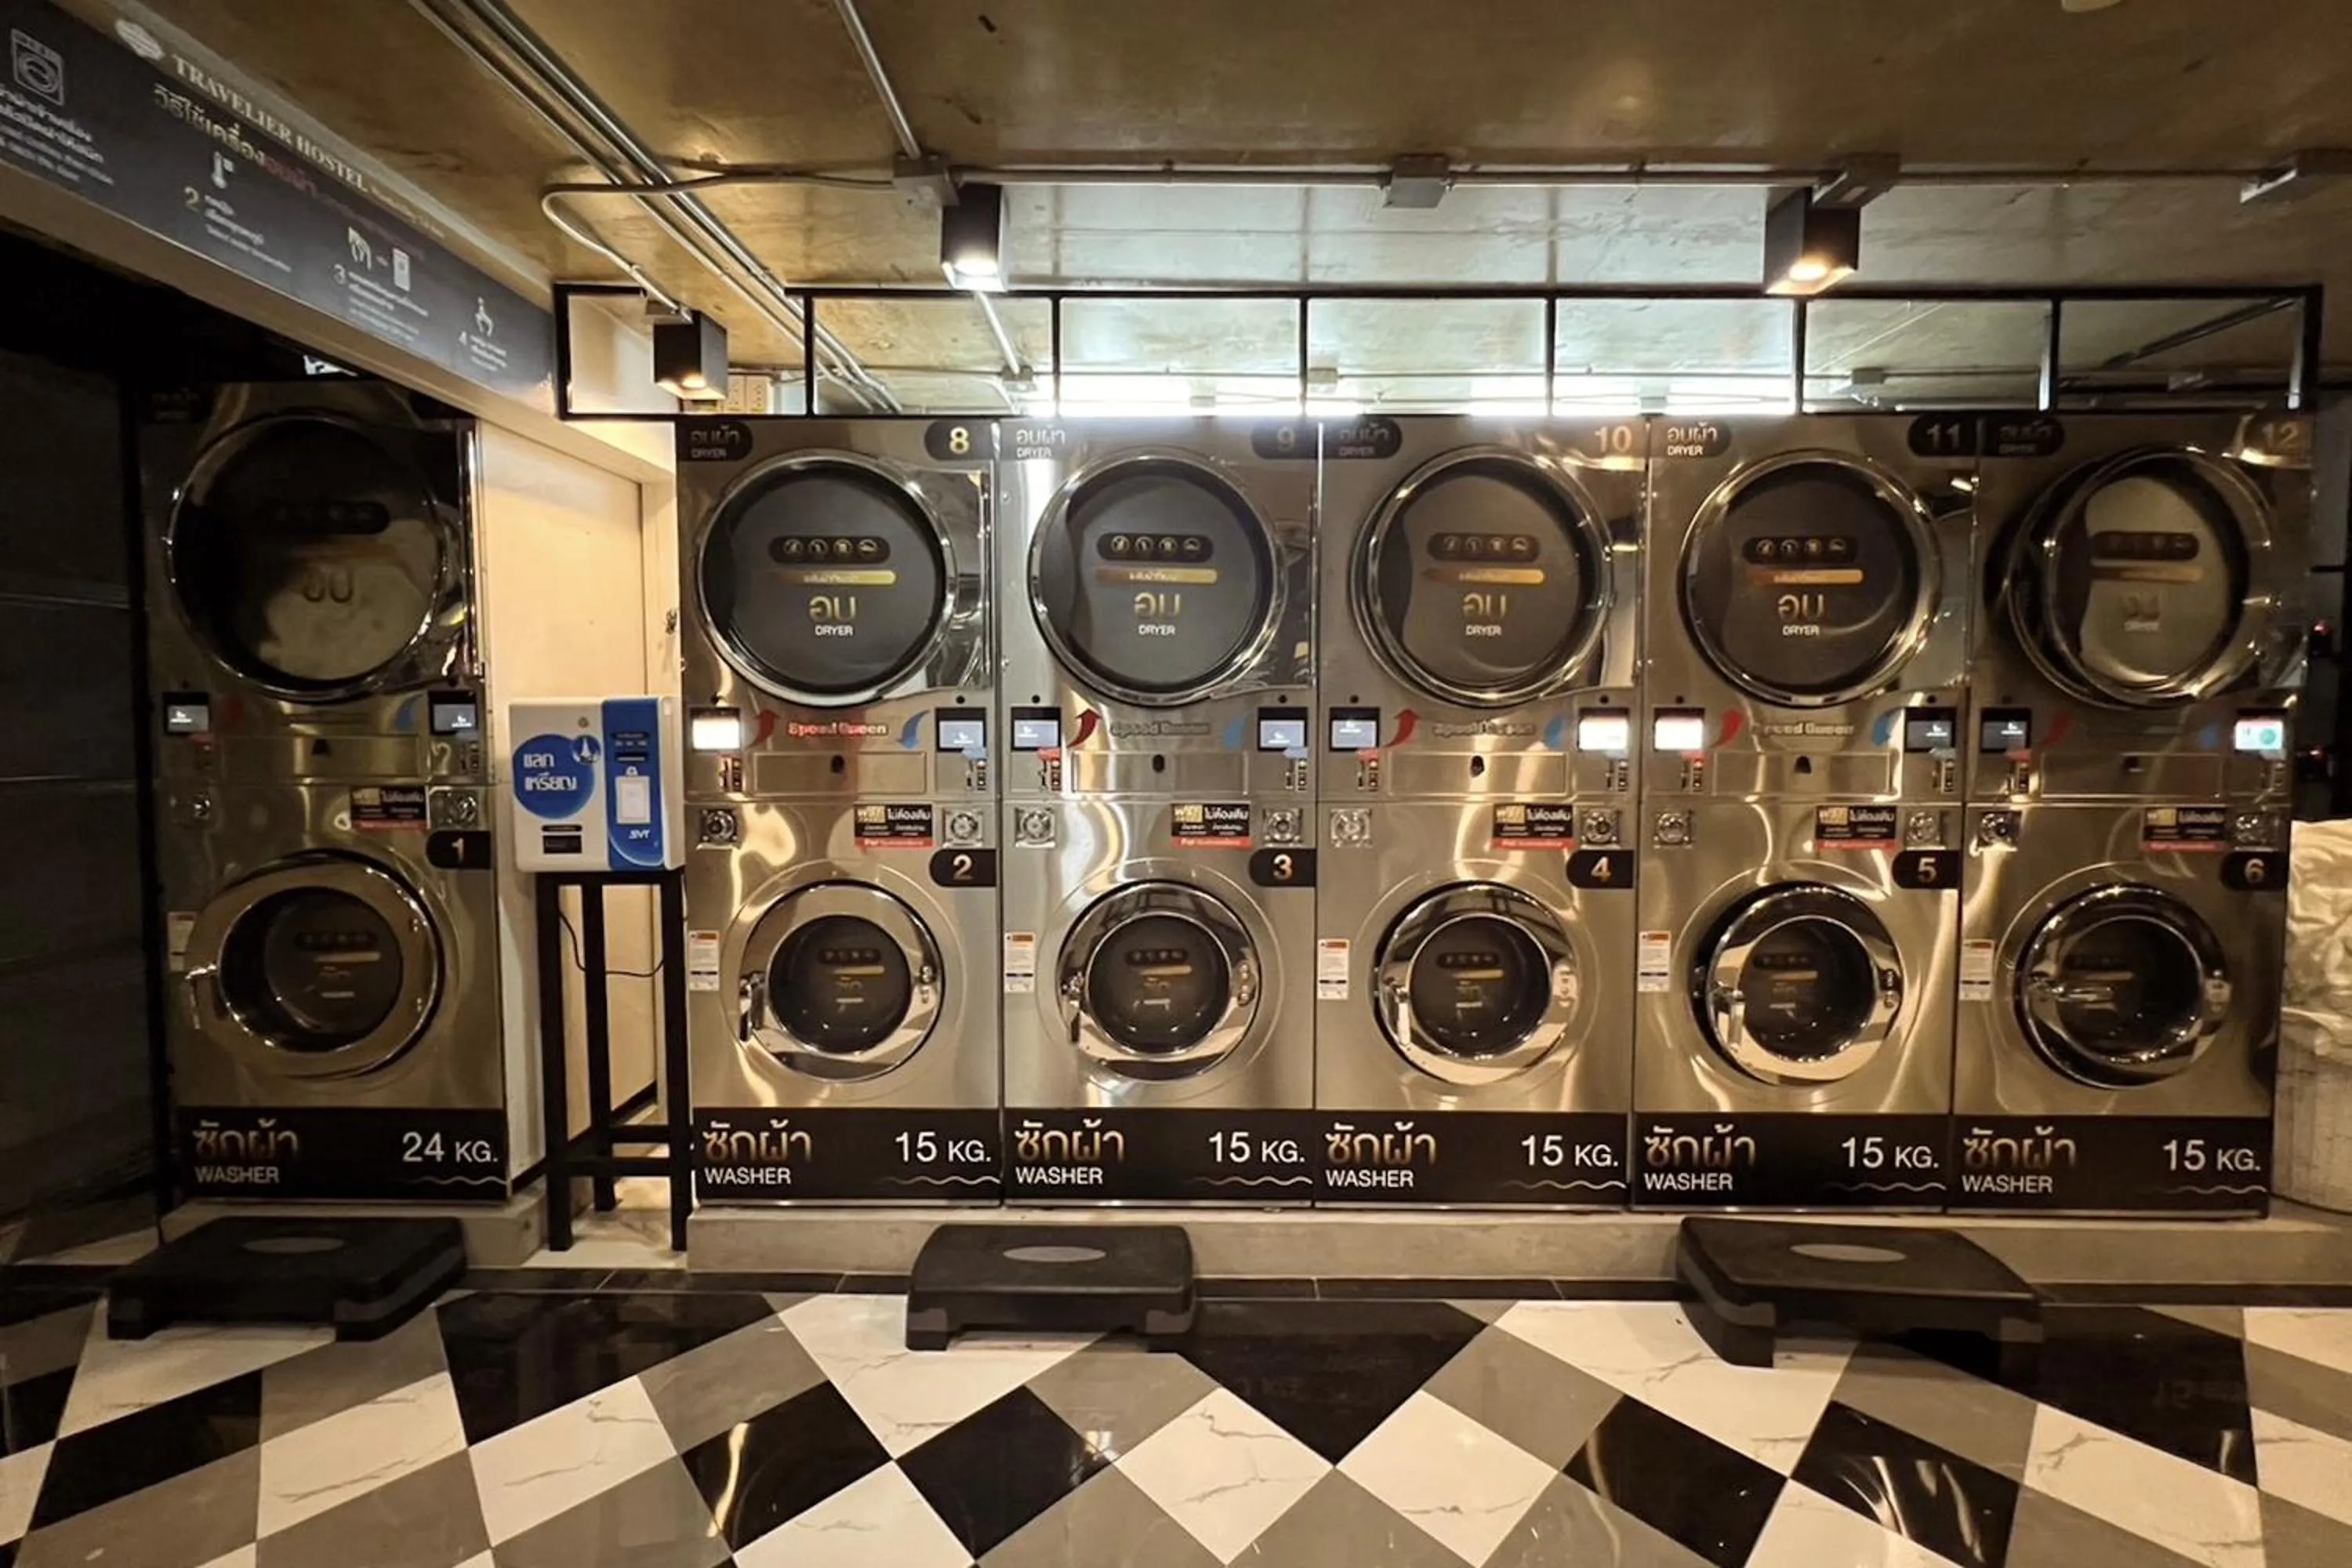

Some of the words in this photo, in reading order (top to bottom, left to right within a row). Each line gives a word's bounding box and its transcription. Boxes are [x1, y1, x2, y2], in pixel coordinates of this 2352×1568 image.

[172, 53, 292, 145] TRAVELIER
[296, 134, 368, 193] HOSTEL
[183, 187, 200, 212] 2
[949, 426, 970, 454] 8
[1276, 426, 1295, 452] 9
[1594, 426, 1633, 452] 10
[1926, 423, 1959, 448] 11
[2263, 422, 2299, 450] 12
[691, 448, 728, 459] DRYER
[1016, 447, 1052, 458] DRYER
[1668, 445, 1704, 456] DRYER
[815, 625, 854, 637] DRYER
[1138, 624, 1175, 636] DRYER
[1465, 625, 1502, 636] DRYER
[1782, 624, 1819, 636] DRYER
[788, 721, 837, 738] Speed
[838, 721, 888, 736] Queen
[524, 753, 555, 768] แลก
[524, 771, 577, 792] เหรียญ
[450, 837, 464, 860] 1
[953, 854, 973, 880] 2
[1272, 854, 1293, 880] 3
[1590, 856, 1611, 880] 4
[1917, 858, 1937, 883] 5
[2245, 858, 2265, 882] 6
[402, 1131, 445, 1163] 24
[456, 1141, 499, 1163] KG.
[702, 1118, 811, 1162] ซักผ้า
[895, 1131, 938, 1163] 15
[948, 1140, 992, 1163] KG.
[1014, 1118, 1126, 1163] ซักผ้า
[1208, 1131, 1250, 1163] 15
[1261, 1141, 1305, 1163] KG.
[1325, 1121, 1436, 1166] ซักผ้า
[1521, 1134, 1564, 1167] 15
[1574, 1145, 1619, 1167] KG.
[1644, 1123, 1756, 1167] ซักผ้า
[1962, 1125, 2077, 1168] ซักผ้า
[1841, 1137, 1884, 1169] 15
[1894, 1146, 1940, 1169] KG.
[2162, 1139, 2207, 1171] 15
[2216, 1149, 2261, 1172] KG.
[194, 1166, 279, 1184] WASHER
[704, 1168, 791, 1185] WASHER
[1015, 1167, 1104, 1185] WASHER
[1326, 1170, 1414, 1188] WASHER
[1644, 1173, 1733, 1191] WASHER
[1962, 1174, 2053, 1194] WASHER
